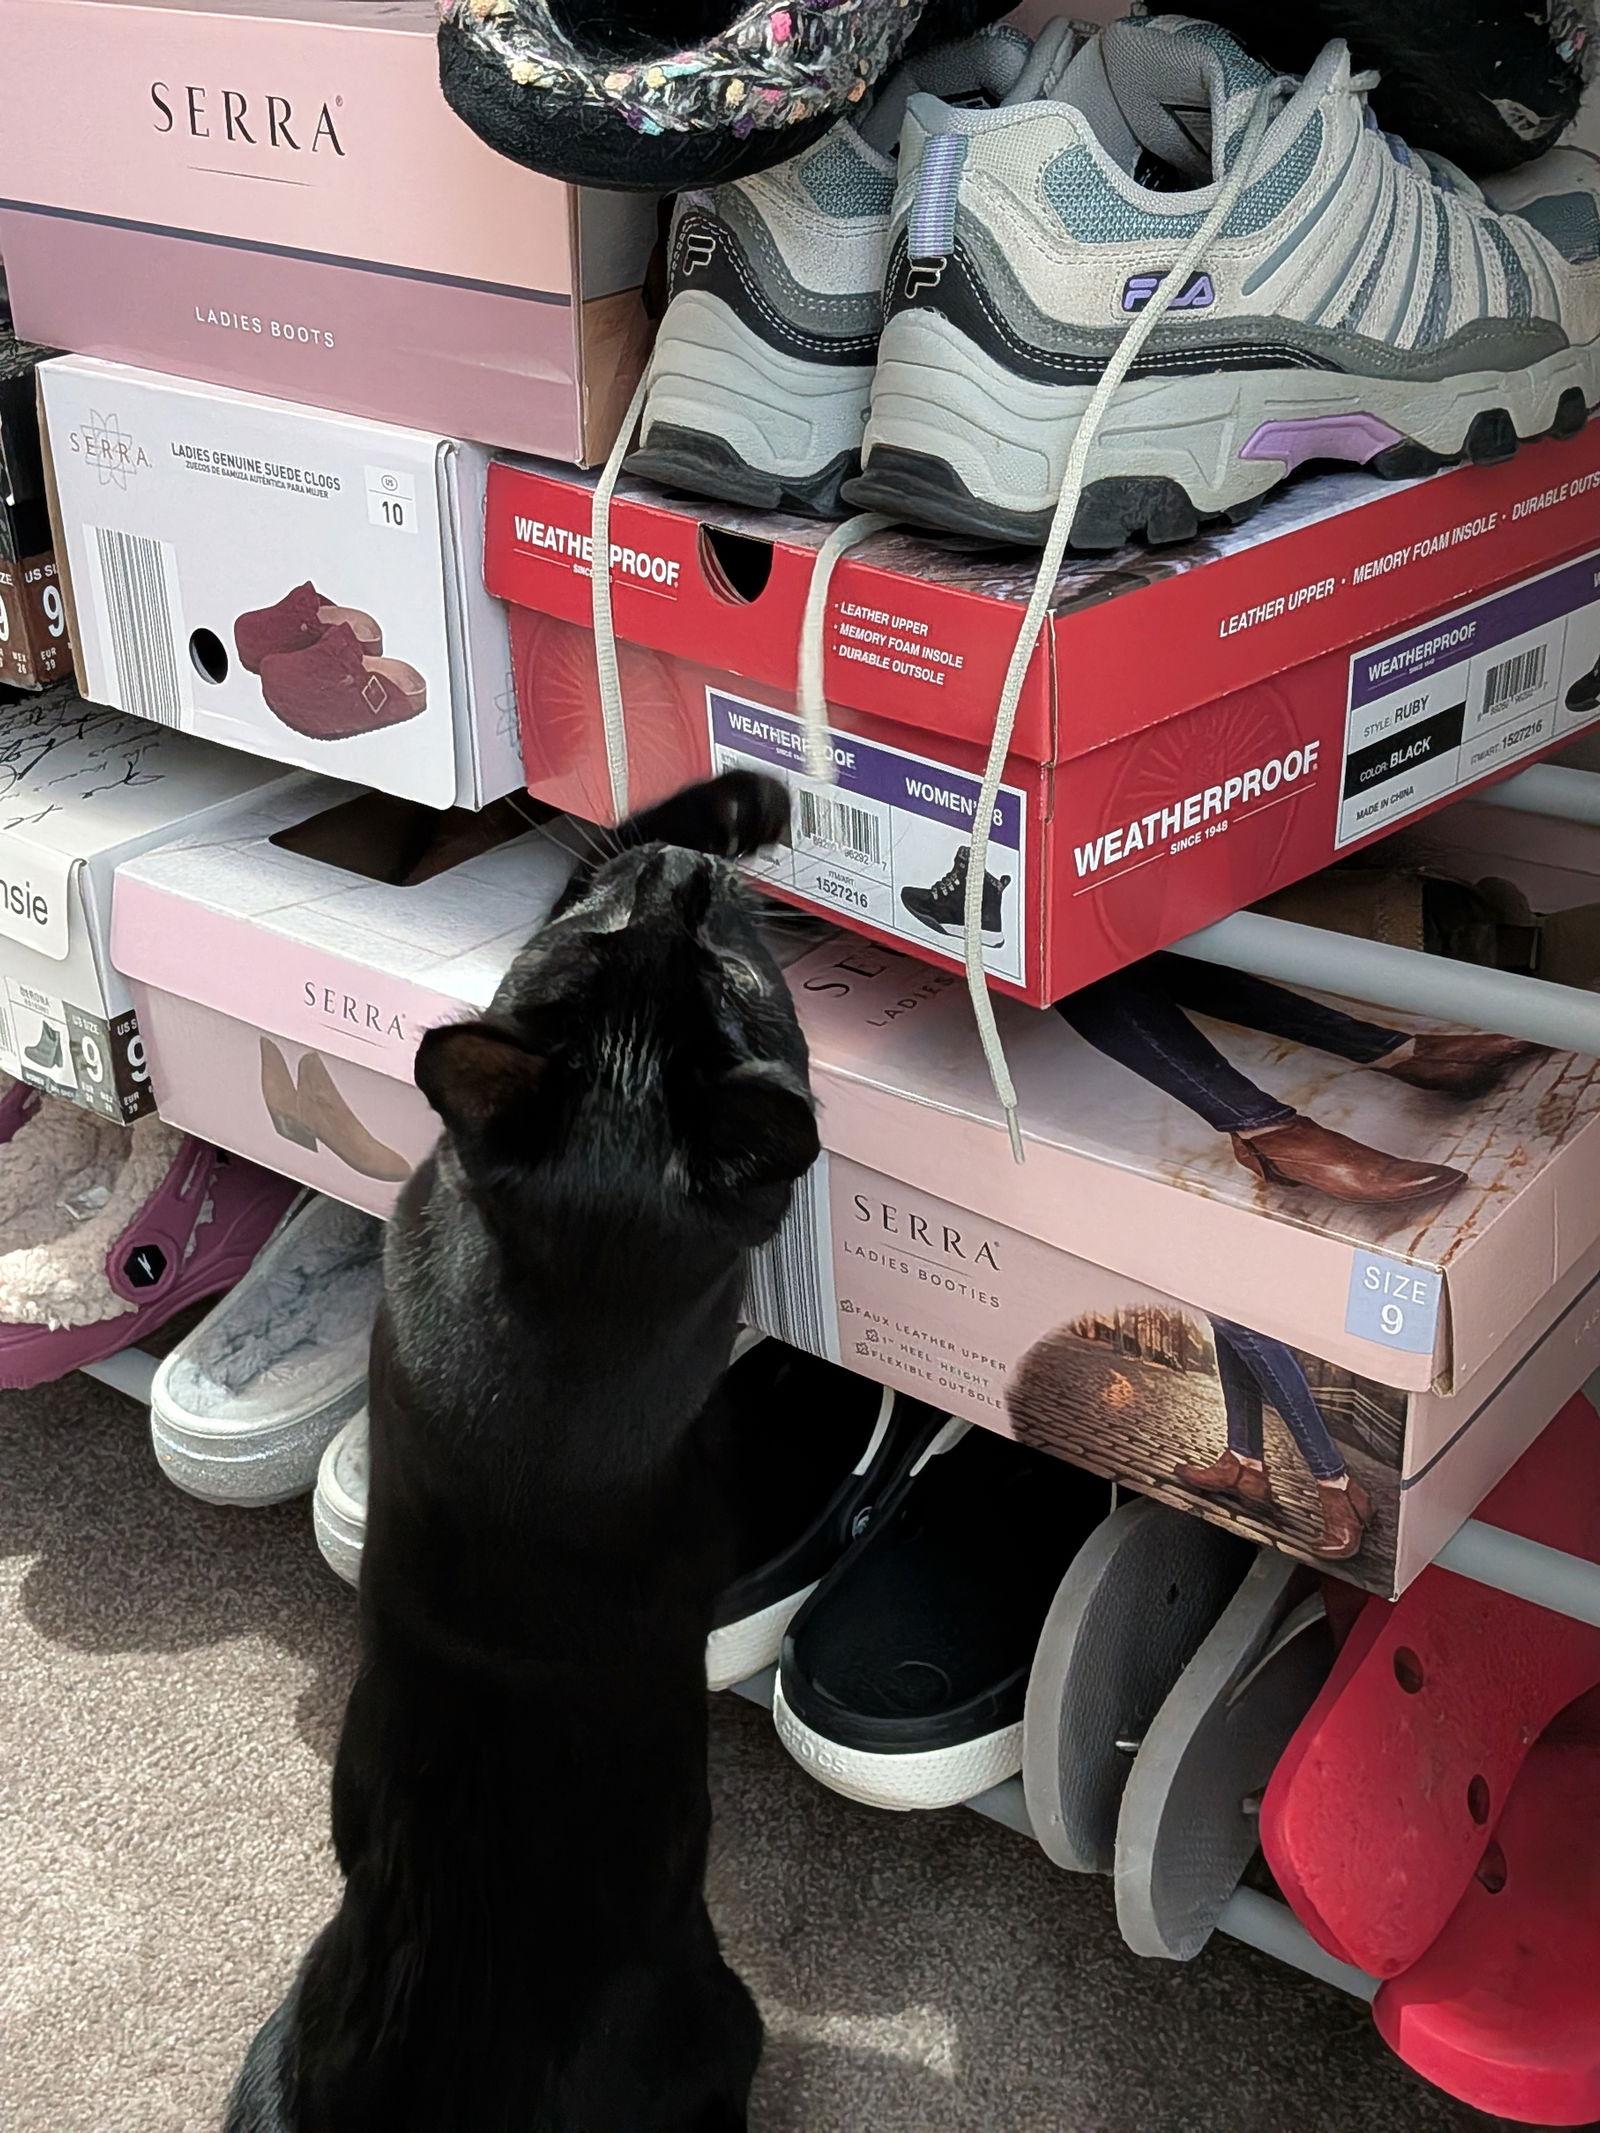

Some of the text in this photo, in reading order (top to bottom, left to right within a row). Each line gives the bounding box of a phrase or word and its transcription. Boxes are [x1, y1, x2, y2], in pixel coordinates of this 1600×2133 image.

[195, 306, 335, 348] LADIES BOOTS
[70, 432, 149, 468] SERRA
[171, 442, 341, 491] LADIES GENUINE SUEDE CLOGS
[211, 466, 221, 476] DE
[287, 482, 305, 494] PARA
[382, 501, 403, 526] 10
[514, 515, 680, 587] WEATHEPROOF
[1219, 597, 1286, 638] LEATHER
[1288, 577, 1335, 611] UPPER
[1352, 547, 1411, 586] MEMORY
[1412, 531, 1450, 561] FOAM
[1451, 512, 1498, 545] INSOLE
[1512, 483, 1569, 521] DURABLE
[25, 568, 42, 583] US
[42, 585, 65, 638] 9
[840, 601, 929, 637] LEATHER UPPER
[41, 647, 57, 661] EUR
[838, 644, 945, 686] DURABLE OUTSOLE
[840, 622, 964, 669] MEMORY FOAM INSOLE
[1368, 620, 1477, 682] WEATHERPROOF
[1394, 694, 1430, 723] RUBY
[1389, 736, 1431, 769] BLACK
[1501, 719, 1543, 749] 1527216
[905, 777, 1003, 827] WOMEN' 8
[1073, 740, 1320, 878] WEATHERPROOF
[1356, 785, 1414, 821] MADE IN CHINA
[1170, 820, 1229, 856] SINCE 1948
[816, 876, 868, 908] 1527216
[303, 982, 405, 1040] SERRA
[866, 976, 955, 1027] LADIES
[117, 1022, 131, 1036] US
[81, 1035, 103, 1083] 9
[123, 1091, 139, 1106] EUR
[129, 1103, 138, 1114] 39
[854, 1194, 1001, 1272] SERRA
[844, 1240, 1001, 1309] LADIES BOOTIES
[1363, 1265, 1427, 1305] SIZE
[855, 1306, 1007, 1373] FAUX LEATHER UPPER
[1380, 1303, 1403, 1335] 9
[871, 1350, 1002, 1409] FLEXIBLE OUTSOLE
[900, 1343, 933, 1362] HEEL
[940, 1361, 990, 1387] HEIGHT
